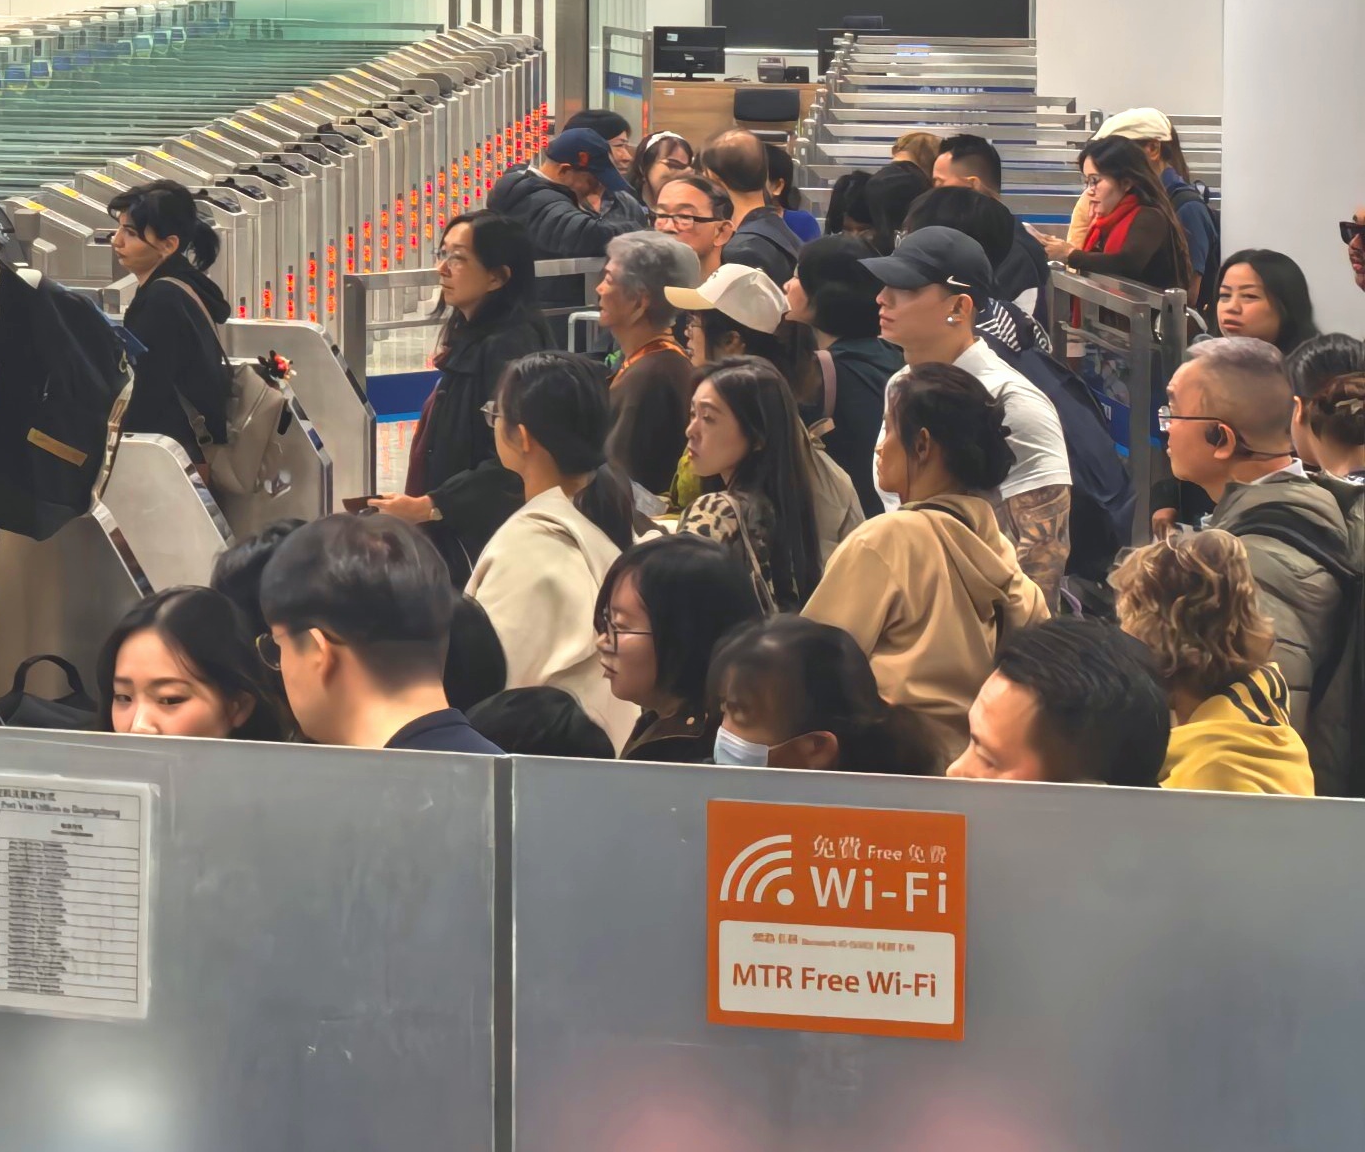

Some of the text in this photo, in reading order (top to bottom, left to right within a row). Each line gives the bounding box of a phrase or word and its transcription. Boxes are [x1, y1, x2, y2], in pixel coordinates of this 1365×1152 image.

[868, 844, 903, 861] Free
[810, 866, 947, 914] Wi-Fi
[733, 963, 936, 998] MTR Free Wi-Fi
